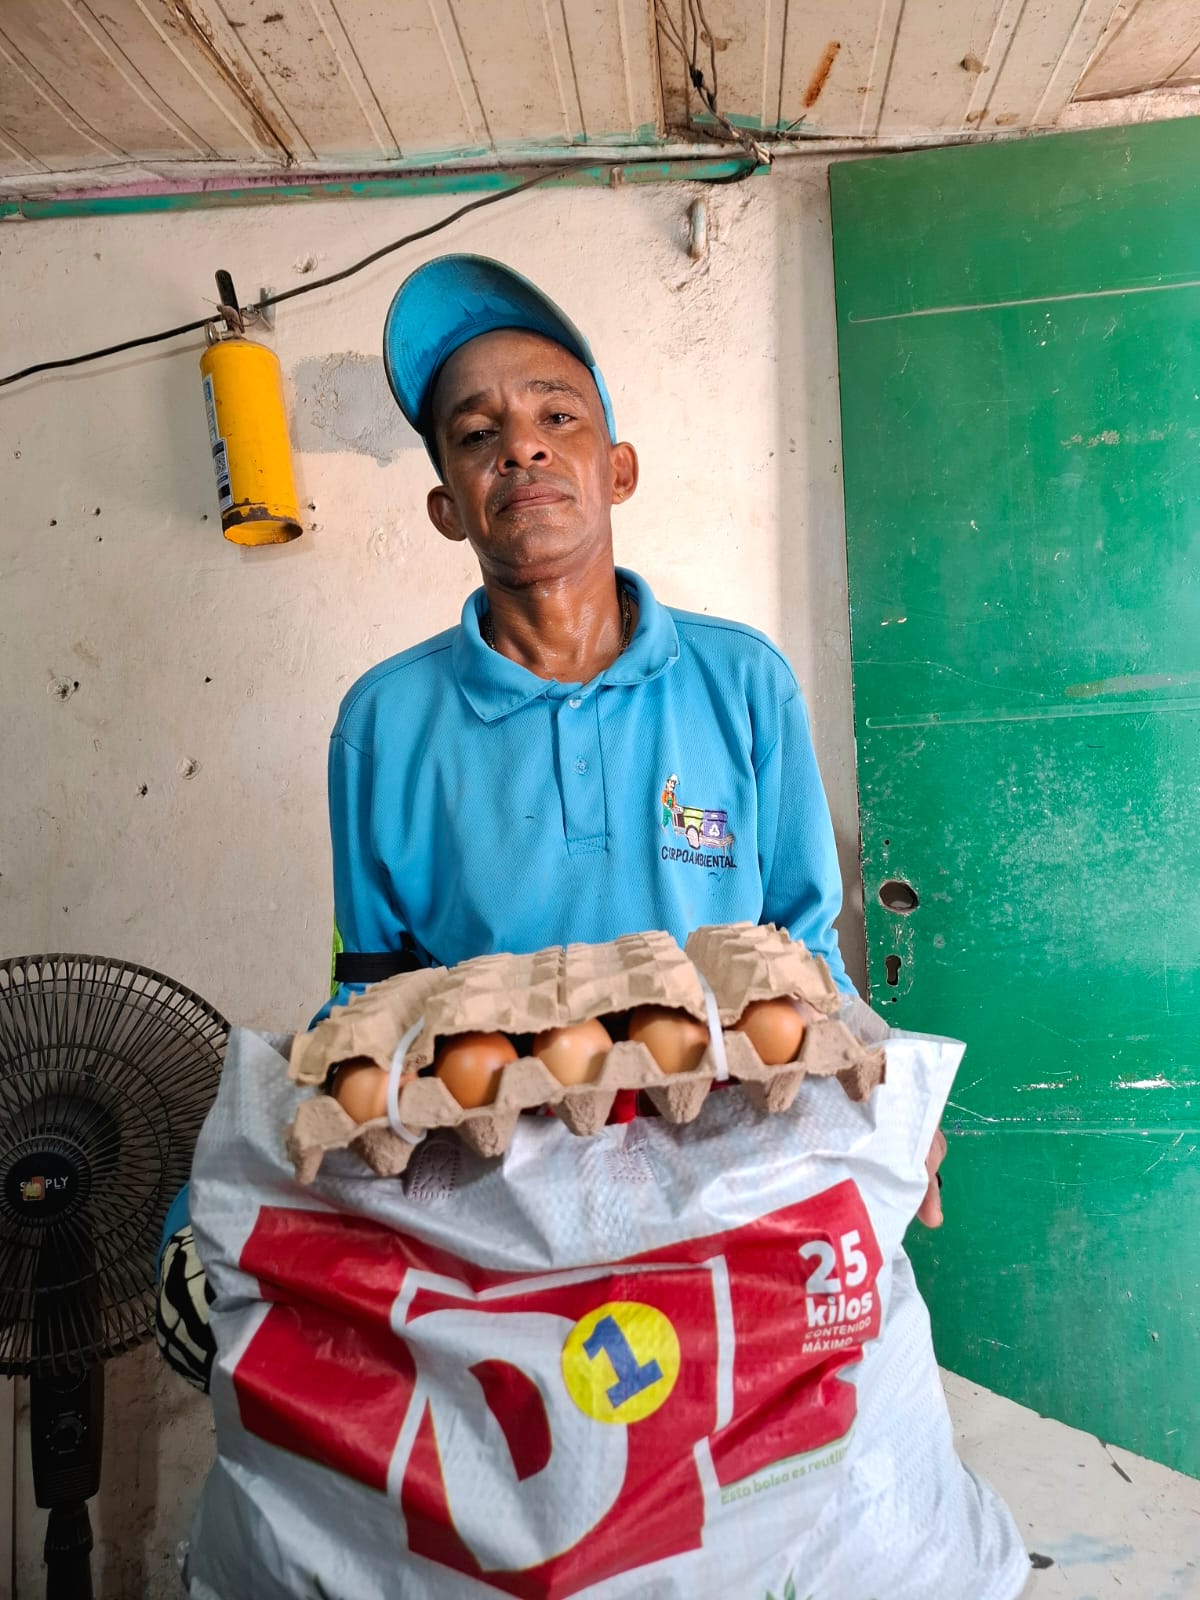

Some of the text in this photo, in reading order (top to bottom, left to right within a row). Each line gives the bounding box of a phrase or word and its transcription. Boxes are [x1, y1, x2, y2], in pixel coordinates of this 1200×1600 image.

[19, 1176, 69, 1192] SPLY
[798, 1229, 868, 1294] 25
[805, 1291, 873, 1328] kilos
[804, 1316, 871, 1339] CONTENIDO
[753, 1472, 790, 1493] bolsa
[791, 1466, 806, 1480] es
